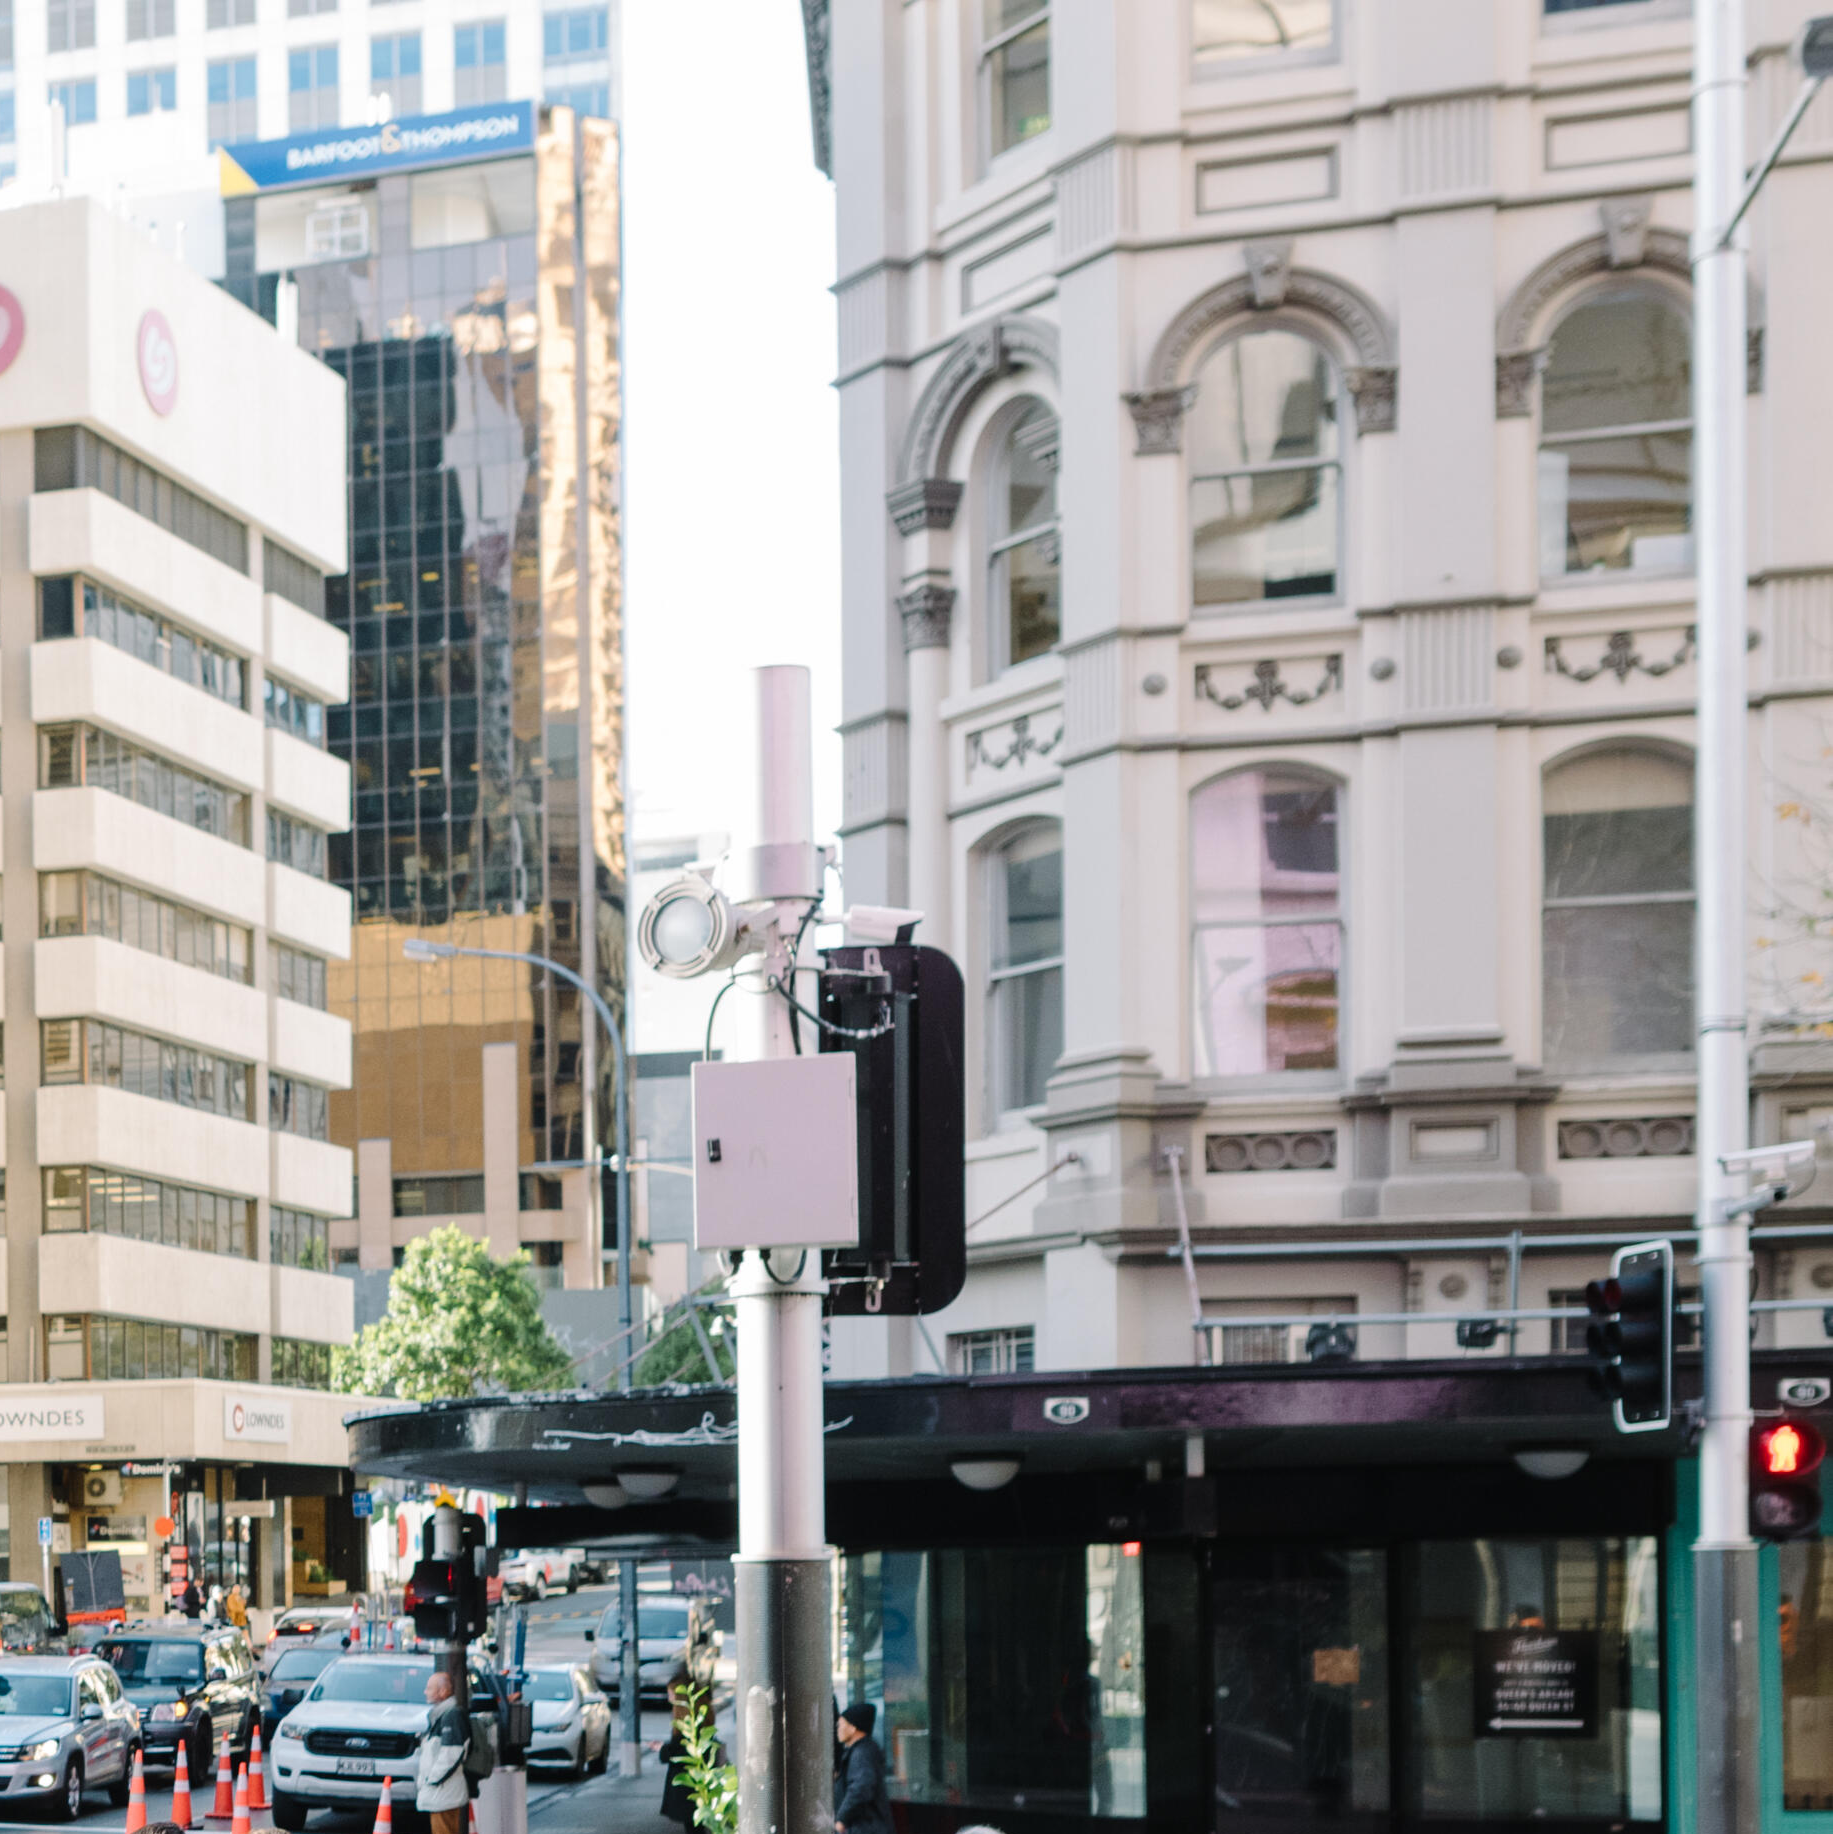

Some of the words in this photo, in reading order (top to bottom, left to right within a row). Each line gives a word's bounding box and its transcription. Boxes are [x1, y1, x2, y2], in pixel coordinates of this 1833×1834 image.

[287, 138, 379, 170] BARFOOT
[381, 124, 401, 154] &
[402, 114, 519, 149] THOMPSON
[245, 1412, 285, 1430] LOWNDES
